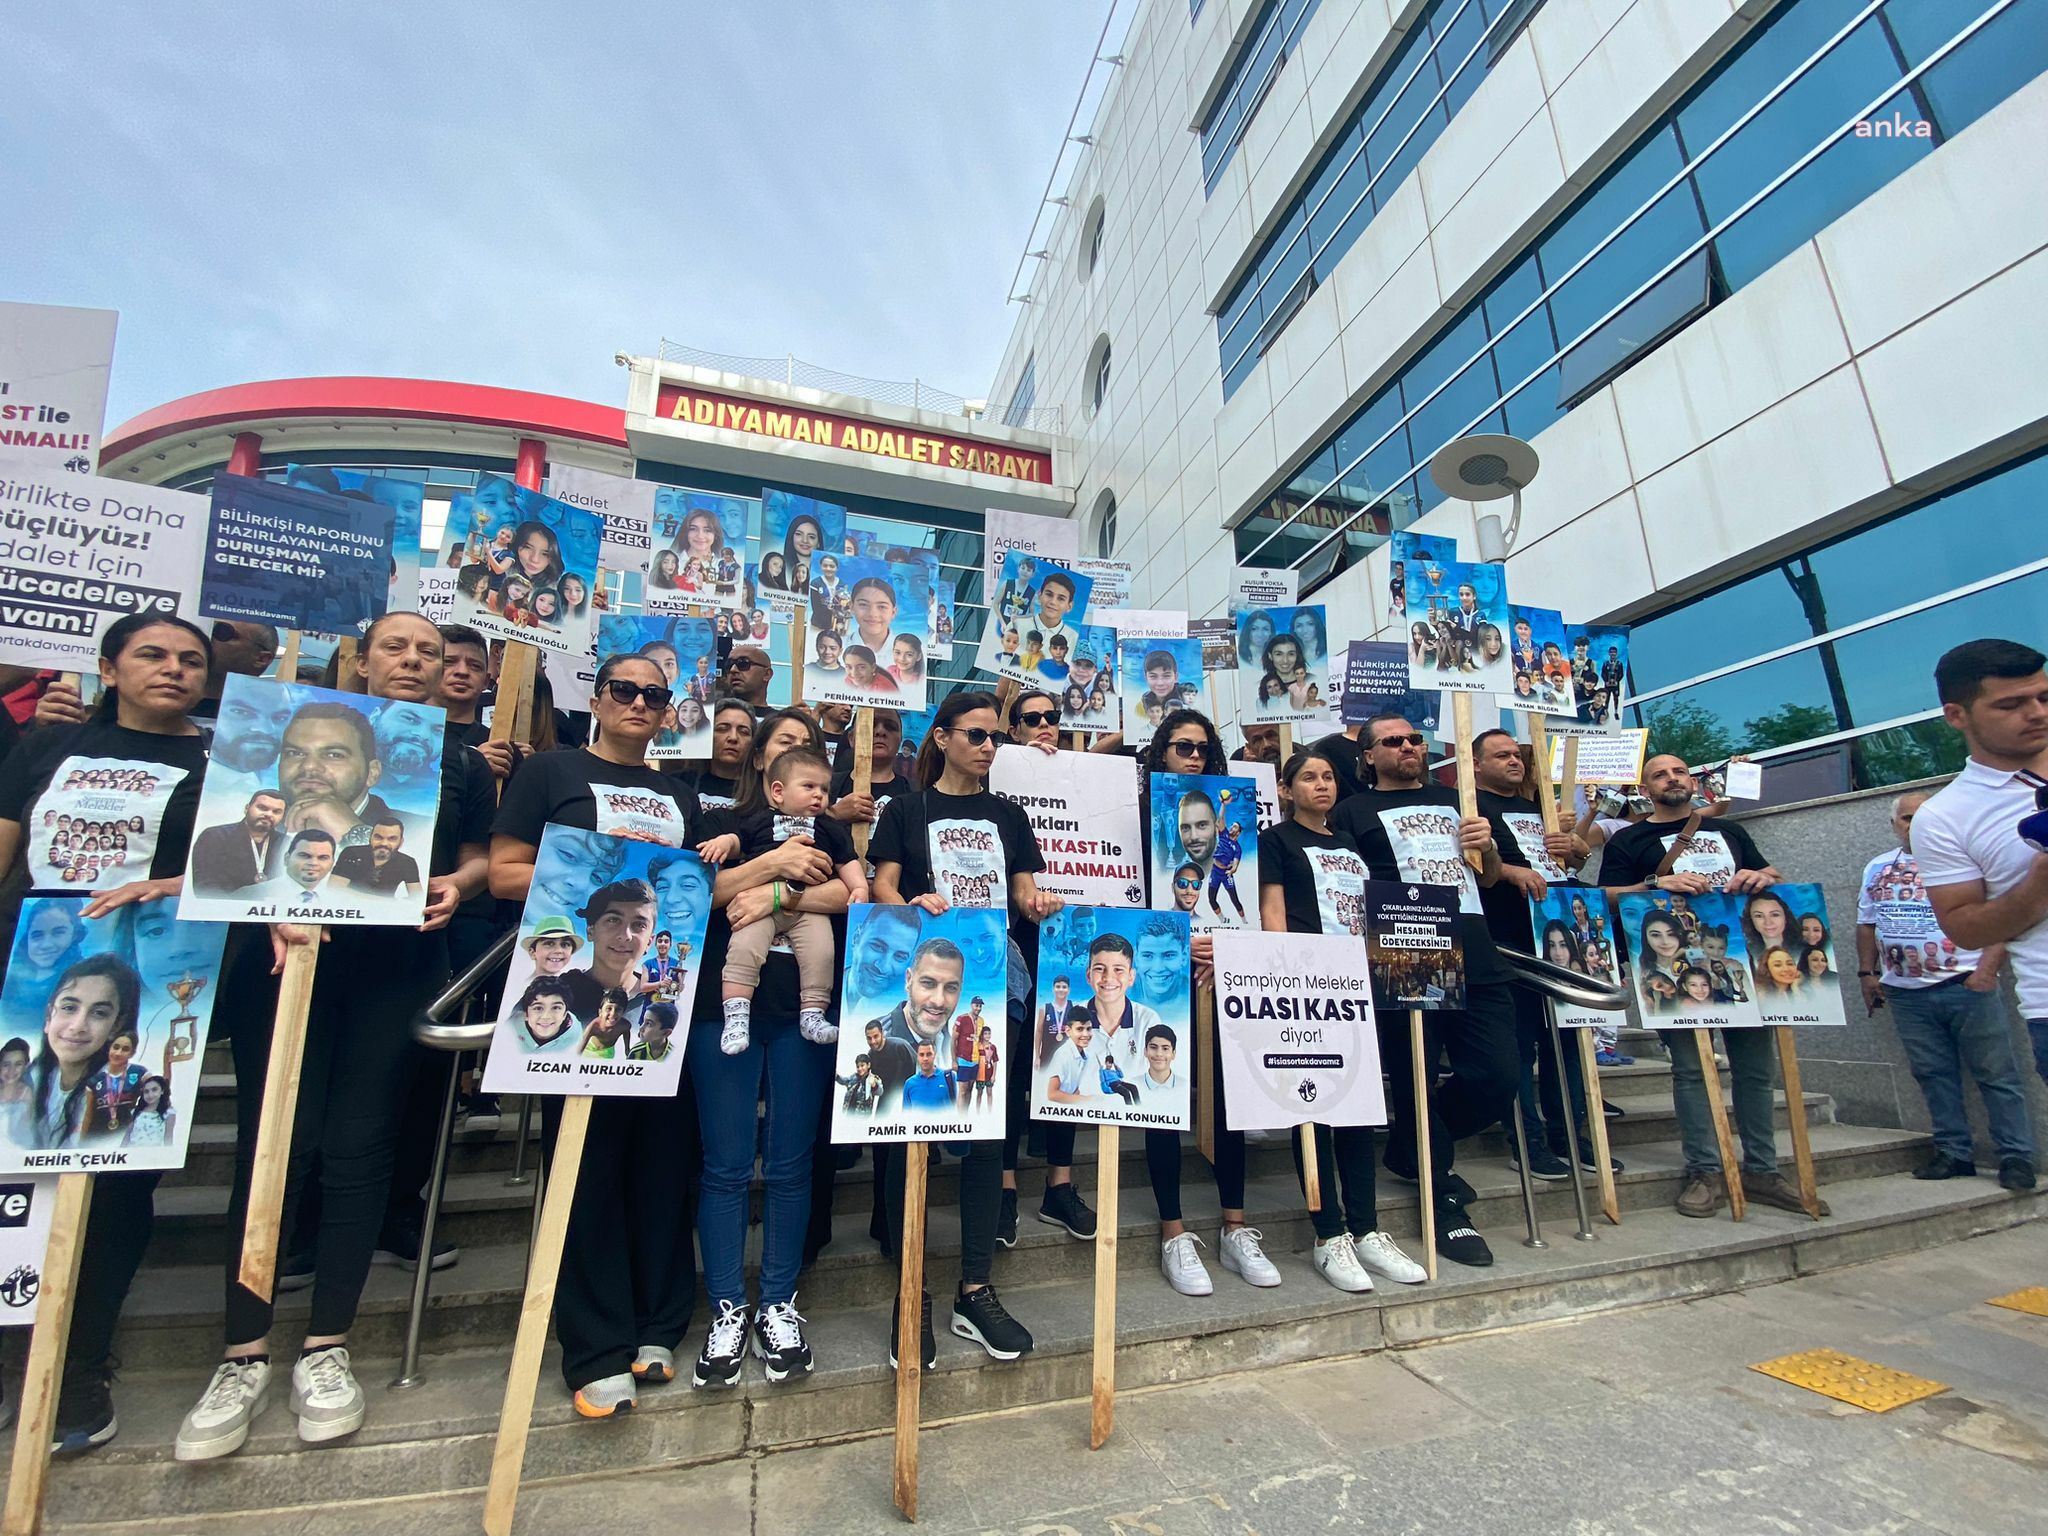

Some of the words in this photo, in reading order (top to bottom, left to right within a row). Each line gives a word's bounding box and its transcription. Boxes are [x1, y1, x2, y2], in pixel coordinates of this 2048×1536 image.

[2, 405, 35, 421] ST
[38, 405, 70, 424] ile
[0, 429, 90, 450] NMALI!
[671, 395, 833, 446] ADIYAMAN
[840, 425, 944, 464] ADALET
[950, 444, 1041, 482] SARAYI
[558, 490, 609, 509] Adalet
[100, 498, 185, 530] Daha
[0, 508, 152, 551] üçlüyüz!
[220, 508, 292, 533] BİLİRKİŞİ
[296, 523, 384, 548] RAPORUNU
[606, 515, 648, 533] KAST
[218, 523, 350, 556] HAZIRLAYANLAR
[353, 549, 374, 560] DA
[601, 530, 650, 548] LECEK!
[994, 537, 1037, 552] Adalet
[216, 537, 321, 565] DURUŞMAYA
[0, 539, 80, 569] dalet
[88, 548, 143, 580] İçin
[215, 552, 294, 575] GELECEK
[297, 565, 327, 579] Mİ?
[0, 568, 177, 615] ücadeleye
[668, 594, 688, 602] LAVİN
[763, 591, 786, 600] DUYGU
[420, 593, 455, 608] yüz!
[2, 606, 96, 634] vam!
[469, 617, 501, 632] HAYAL
[503, 627, 569, 651] GENÇALİOĞLU
[1118, 628, 1144, 637] piyon
[1145, 628, 1184, 638] Melekler
[0, 635, 97, 656] ortakdavamız
[1351, 660, 1388, 669] BİLİRKİŞİ
[999, 668, 1022, 680] AYKAN
[1024, 675, 1040, 685] EKİZ
[1350, 669, 1409, 678] HAZIRLAYANL
[1348, 686, 1389, 694] GELECEK
[1389, 687, 1406, 695] Mİ?
[1349, 678, 1403, 687] DURUŞMAYA
[1465, 682, 1485, 690] KILIÇ
[824, 692, 864, 703] PERİHAN
[868, 697, 905, 707] ÇETİNER
[1513, 702, 1535, 710] HASAN
[1537, 704, 1559, 713] BİLGEN
[1256, 715, 1284, 723] BEDRİYE
[1286, 713, 1316, 721] YENİÇERİ
[649, 749, 682, 758] ÇAVDIR
[74, 799, 127, 812] Melekler
[1256, 801, 1273, 816] ST
[1051, 838, 1098, 855] KAST
[1101, 840, 1122, 857] ile
[1038, 860, 1138, 880] ILANMALI!
[247, 904, 276, 917] ALİ
[287, 907, 365, 919] KARASEL
[1381, 904, 1422, 912] ÇIKARLARINIZ
[1422, 905, 1447, 913] UĞRUNA
[1390, 913, 1418, 922] ETTİĞİNİZ
[1418, 915, 1452, 923] HAYATLARIN
[1396, 926, 1436, 935] HESABINI
[1381, 935, 1450, 948] ÖDEYECEKSİNİZ!
[1223, 971, 1301, 992] Şampiyon
[1305, 975, 1365, 990] Melekler
[1223, 995, 1300, 1020] OLASI
[1303, 997, 1369, 1022] KAST
[1589, 1016, 1607, 1024] DAĞLI
[1672, 1017, 1699, 1025] ABİDE
[1703, 1016, 1729, 1025] DAĞLI
[1761, 1014, 1790, 1022] LKİYE
[1793, 1014, 1820, 1022] DAĞLI
[1280, 1027, 1323, 1047] diyor!
[526, 1059, 572, 1074] İZCAN
[579, 1063, 644, 1077] NURLUÖZ
[1267, 1056, 1340, 1067] #isiasortakdavamız
[1039, 1106, 1084, 1118] ATAKAN
[1087, 1109, 1122, 1121] CELAL
[1125, 1112, 1181, 1125] KONUKLU
[868, 1123, 907, 1136] PAMİR
[913, 1124, 973, 1135] KONUKLU
[24, 1152, 72, 1167] NEHİR
[80, 1151, 128, 1169] ÇEVİK
